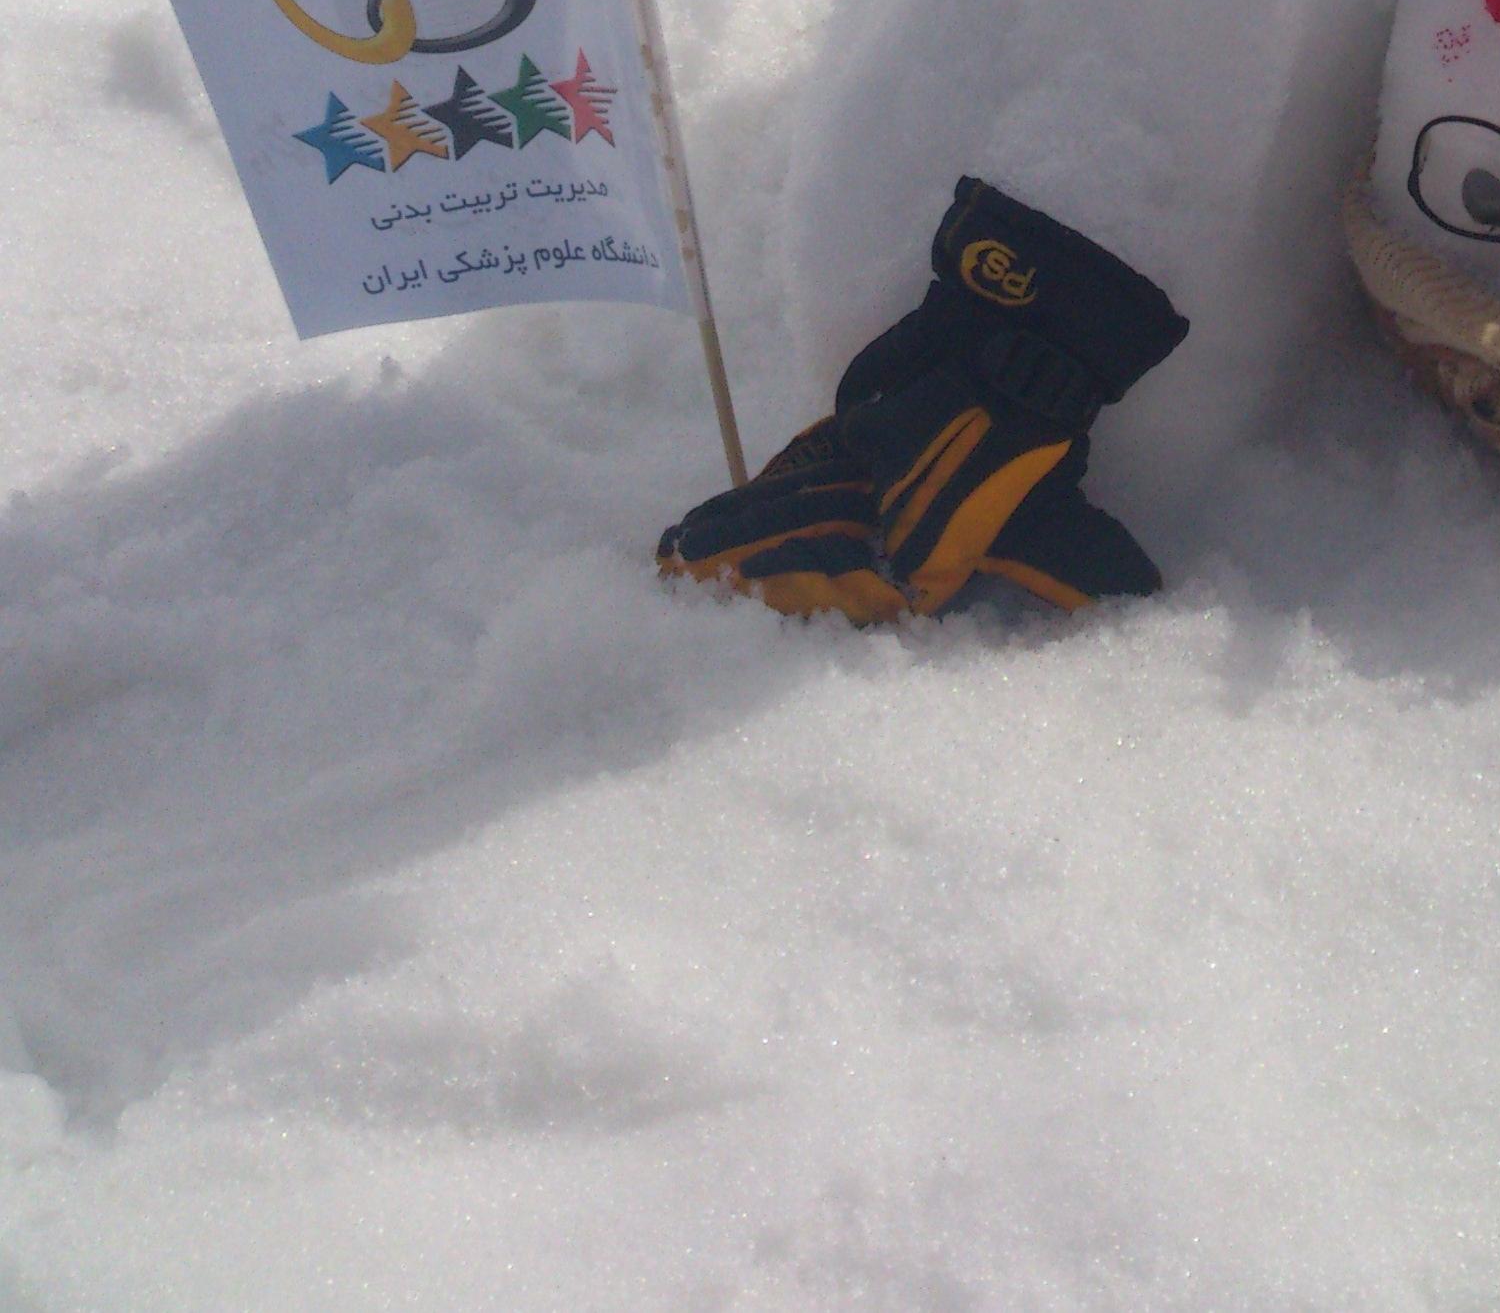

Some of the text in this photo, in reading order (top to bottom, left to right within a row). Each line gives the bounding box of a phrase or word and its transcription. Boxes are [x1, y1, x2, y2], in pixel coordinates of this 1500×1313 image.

[370, 177, 609, 232] مدیریت تربیت بدنی
[362, 235, 660, 296] دانشگاه علوم پزشکی ایران
